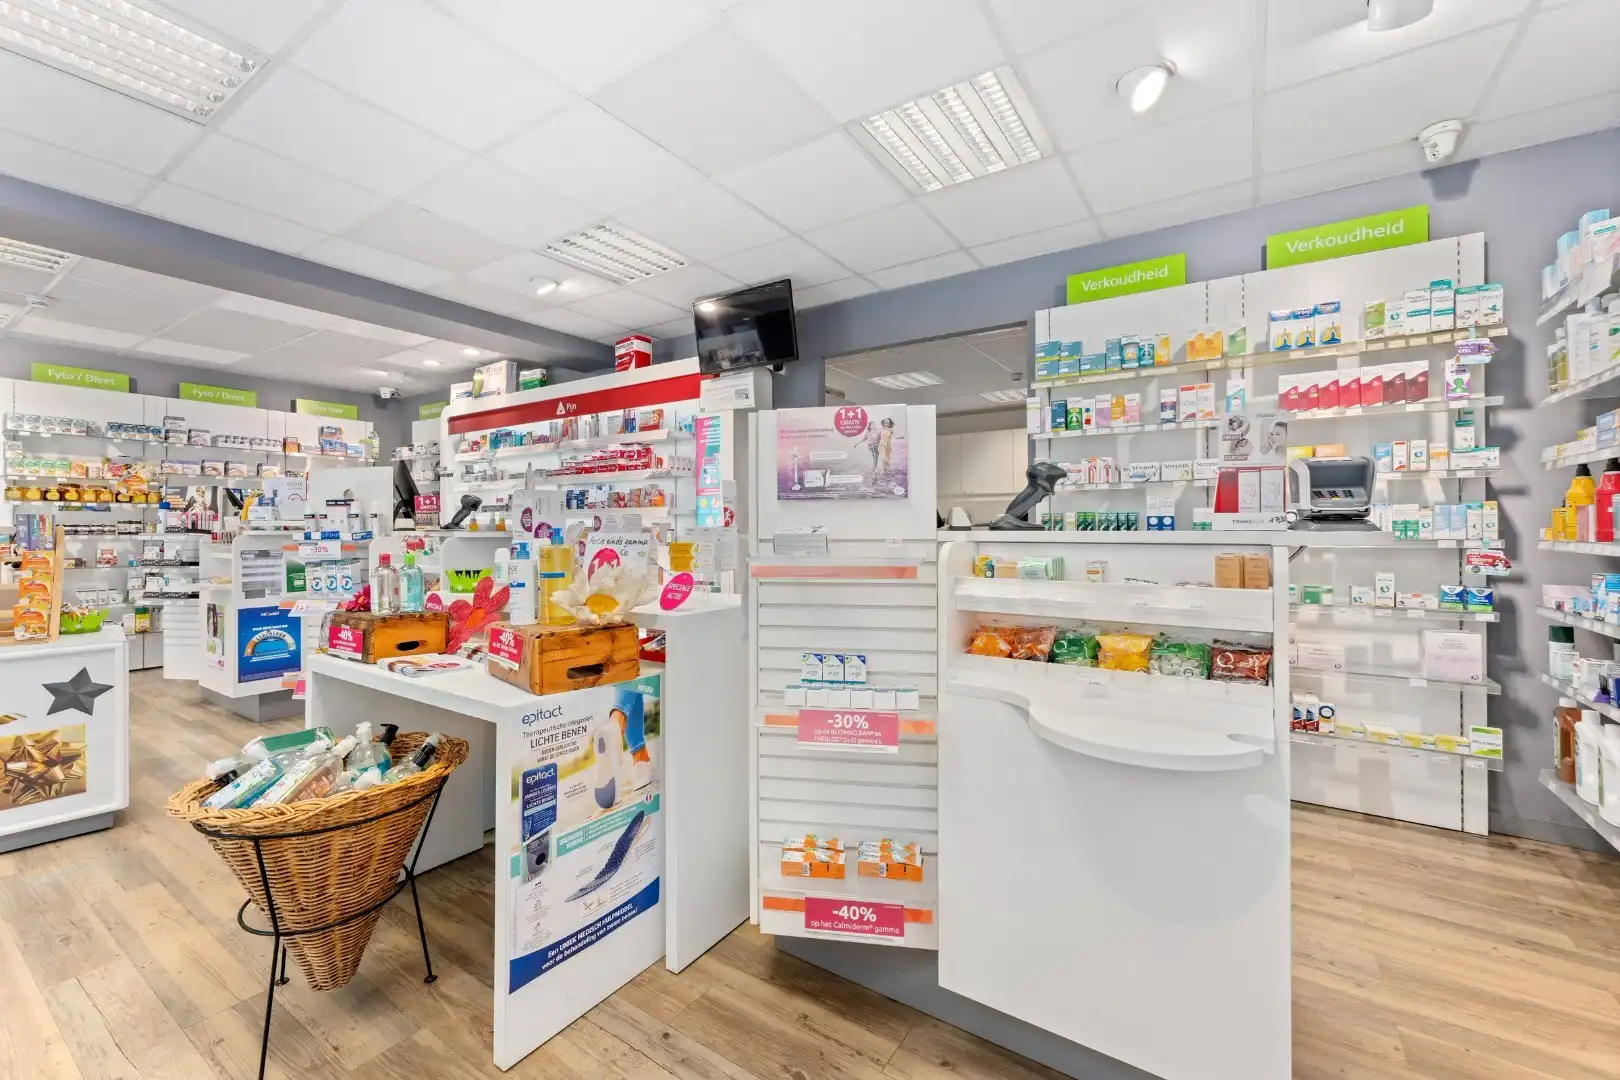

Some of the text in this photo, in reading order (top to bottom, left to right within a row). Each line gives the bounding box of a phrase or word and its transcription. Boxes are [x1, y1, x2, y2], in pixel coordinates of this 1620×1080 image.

[1286, 218, 1404, 255] Verkoudheid
[1081, 265, 1168, 292] Verkoudheid
[48, 369, 75, 380] Fyto
[193, 388, 213, 399] Fyto
[566, 403, 577, 413] Pijn
[839, 409, 862, 419] 1+1
[1131, 464, 1157, 472] Strepsils
[418, 497, 437, 505] 1+1
[311, 545, 329, 553] -30%
[668, 582, 691, 592] SPECIALE
[666, 592, 682, 600] ACTIE
[426, 602, 443, 611] SPECIALE
[337, 630, 353, 642] -40%
[499, 631, 515, 648] -40%
[1217, 651, 1234, 668] Q
[637, 684, 655, 694] NIEUW
[521, 704, 563, 727] epitact
[827, 713, 869, 729] -30%
[522, 721, 567, 740] Therapeutische
[530, 724, 588, 749] LICHTE BENEN
[526, 767, 556, 785] epitact
[832, 905, 877, 922] -40%
[547, 903, 633, 959] Een UNIEK MEDISCH HULPMIDDEL
[811, 920, 820, 928] op
[820, 920, 832, 928] het
[874, 926, 900, 934] gamma
[541, 957, 556, 970] voor
[556, 953, 564, 962] de
[564, 934, 597, 958] behandeling
[596, 927, 607, 937] van
[606, 919, 622, 932] zware
